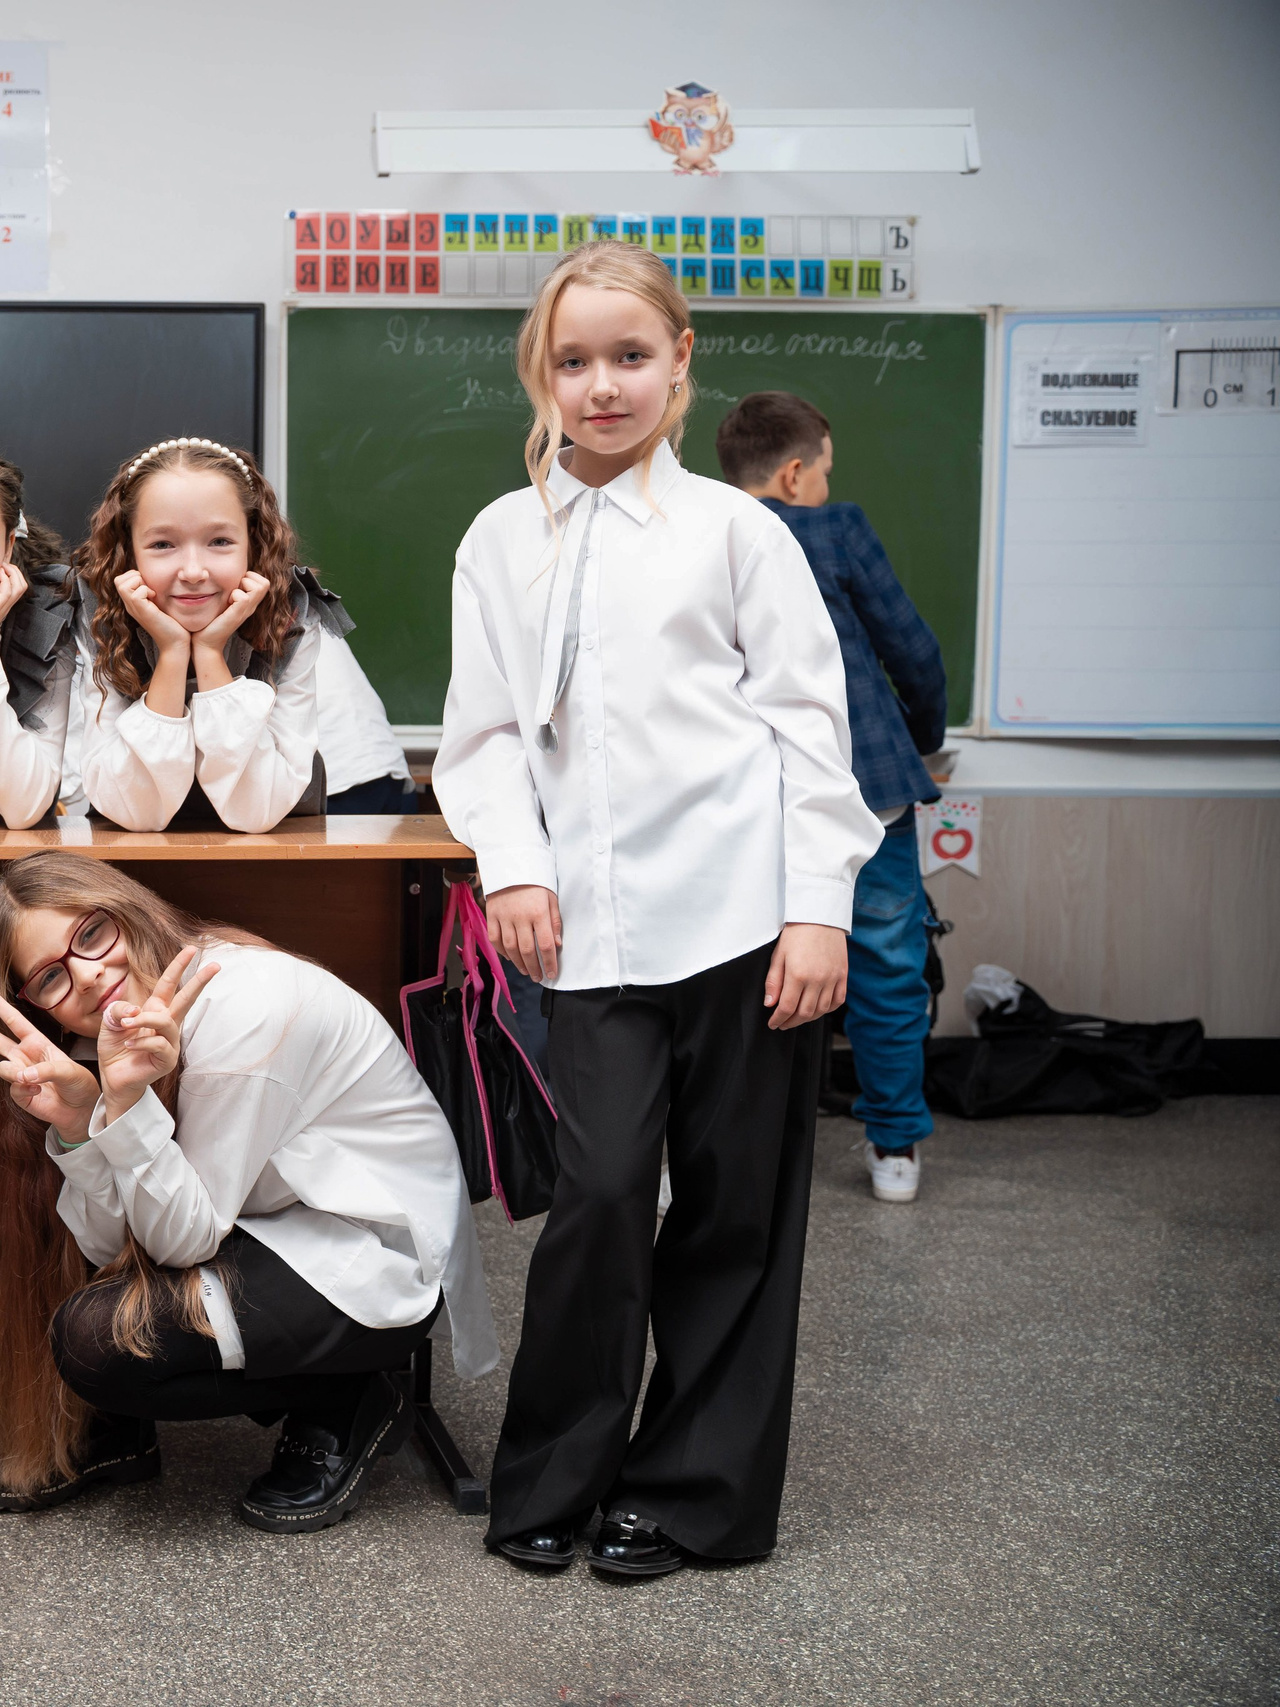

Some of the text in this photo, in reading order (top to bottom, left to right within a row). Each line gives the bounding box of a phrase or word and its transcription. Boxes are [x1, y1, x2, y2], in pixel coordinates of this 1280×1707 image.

[1, 101, 13, 118] 4
[1, 226, 11, 243] 2
[299, 219, 318, 243] А
[329, 219, 347, 243] О
[359, 219, 377, 243] У
[387, 219, 410, 245] Ы
[420, 219, 436, 245] Э
[447, 221, 467, 244] Л
[478, 221, 498, 245] М
[507, 221, 526, 245] Н
[537, 221, 552, 245] Р
[629, 221, 644, 244] В
[658, 222, 672, 246] Г
[683, 223, 703, 250] Д
[711, 224, 734, 248] Ж
[743, 223, 759, 249] З
[889, 225, 909, 249] Ъ
[299, 257, 907, 293] Я Ё Ю И Е Т Ш С Х Ц Ч Щ Ь
[785, 320, 928, 386] октября
[1042, 373, 1139, 389] ПОДЛЕЖАЩЕЕ
[1203, 388, 1218, 408] 0
[1267, 387, 1276, 406] 1
[1041, 409, 1137, 427] СКАЗУЕМОЕ
